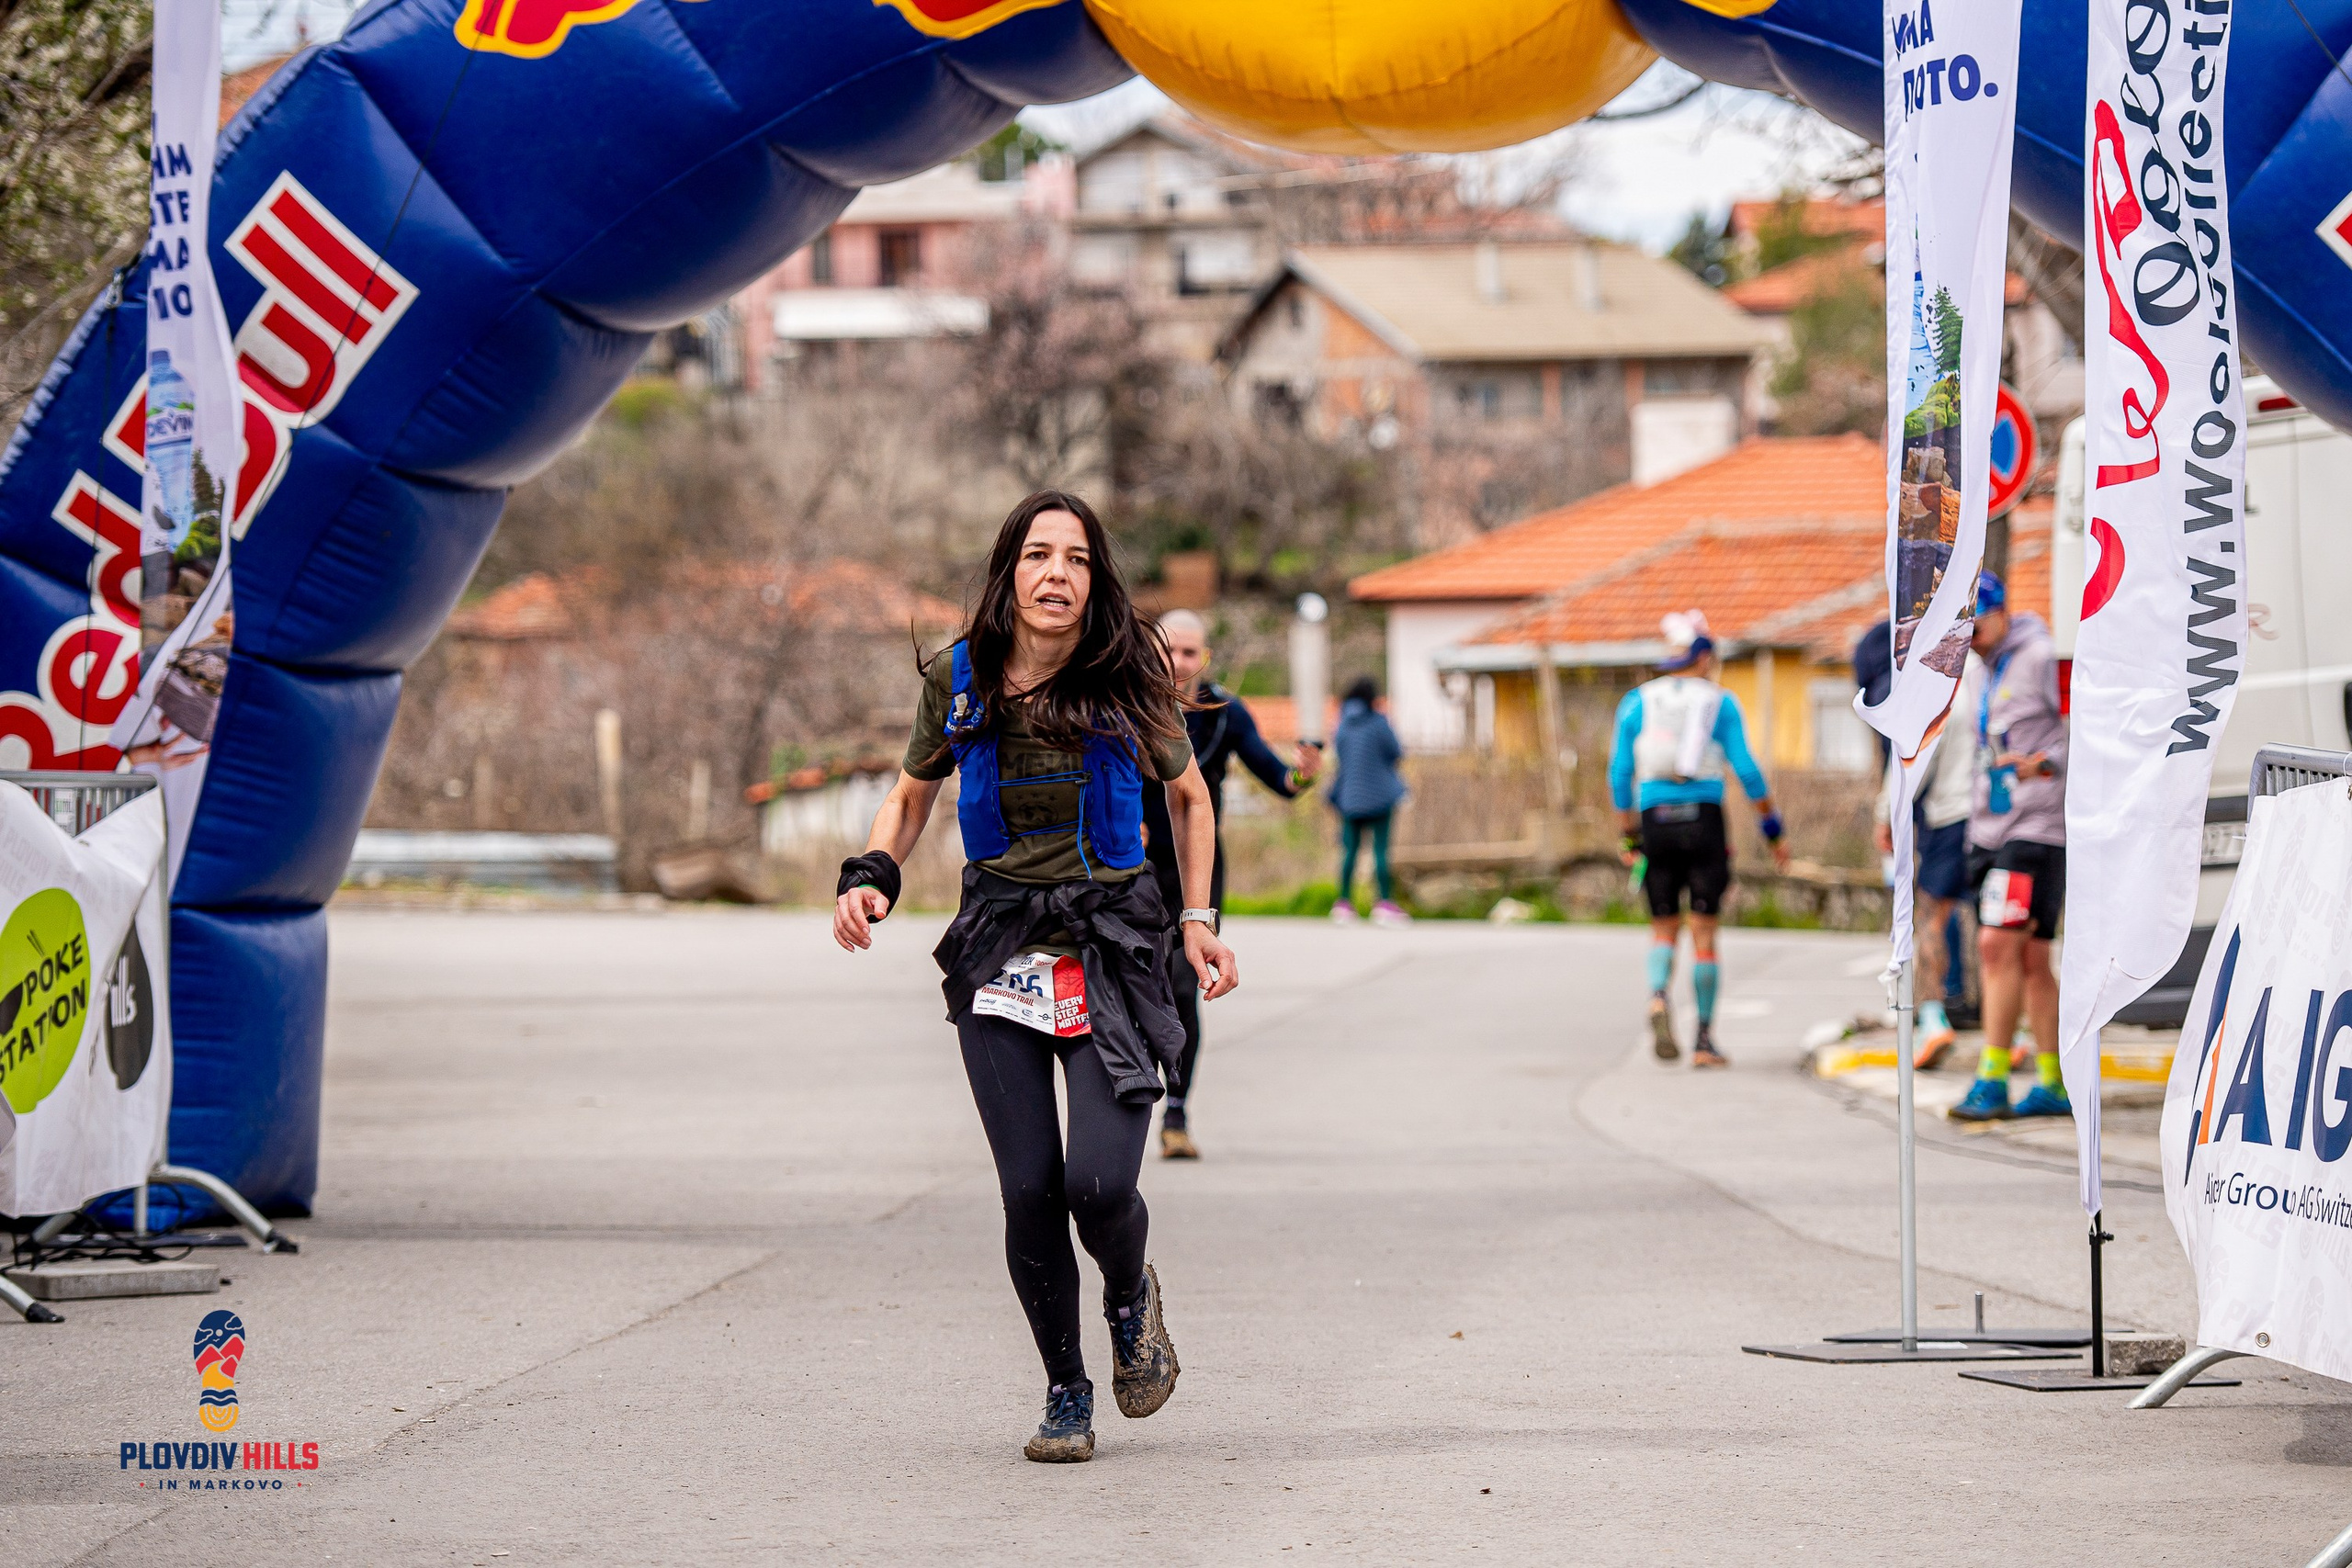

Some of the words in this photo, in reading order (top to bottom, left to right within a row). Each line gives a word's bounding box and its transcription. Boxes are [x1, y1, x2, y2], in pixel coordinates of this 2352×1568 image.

[25, 933, 84, 1007] POKE
[981, 987, 1017, 1000] MARKOVO
[1017, 994, 1035, 1007] TRAIL
[1055, 995, 1084, 1011] EVERY
[1056, 1006, 1080, 1021] STEP
[2297, 1184, 2314, 1220] AG
